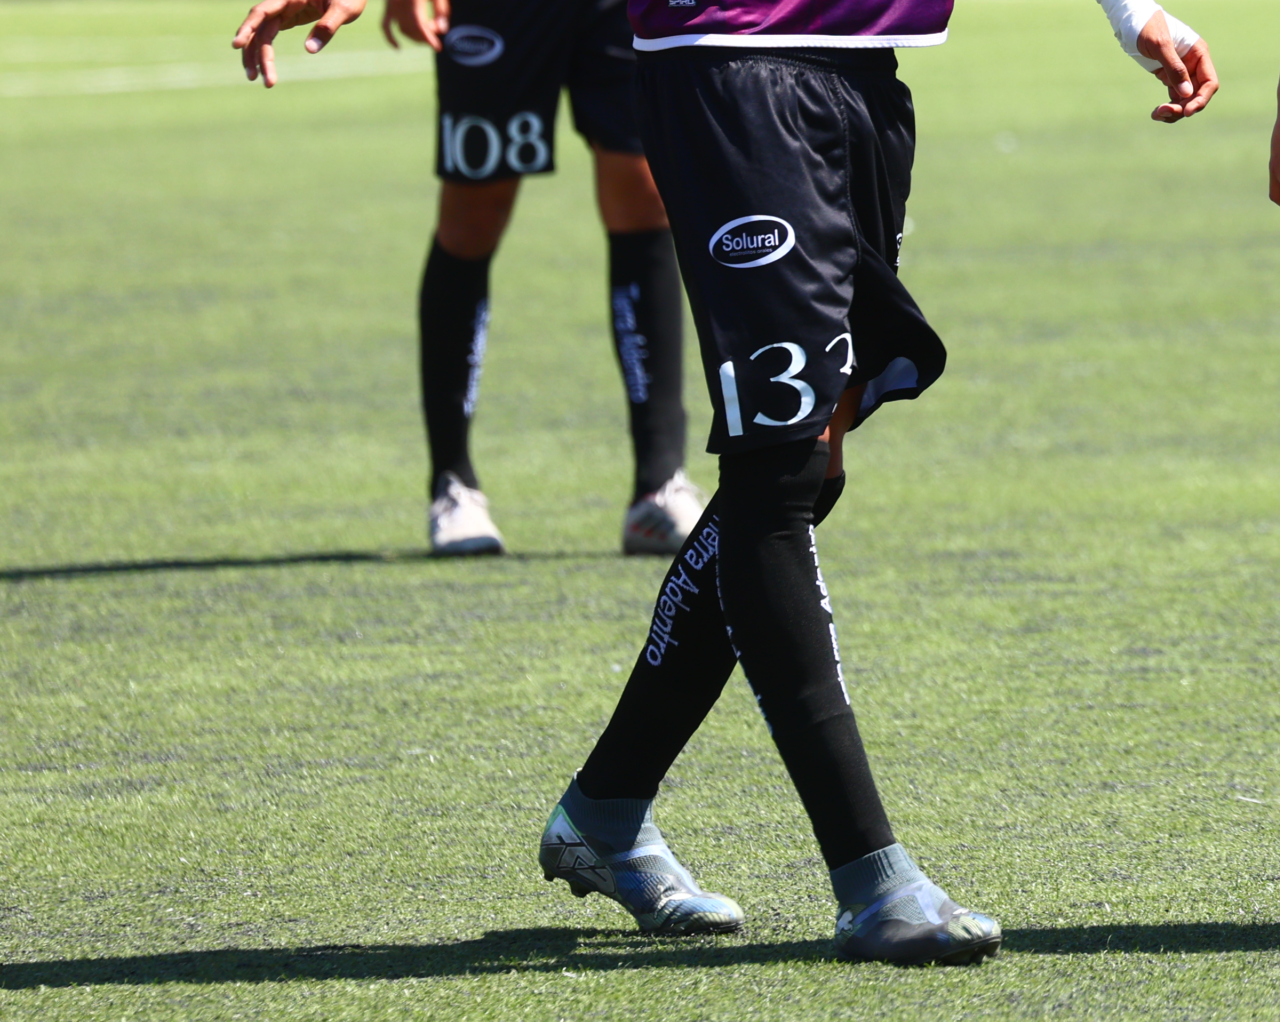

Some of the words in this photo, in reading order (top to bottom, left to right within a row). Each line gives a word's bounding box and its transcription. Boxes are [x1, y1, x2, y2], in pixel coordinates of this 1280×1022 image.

[442, 111, 549, 180] 108
[722, 228, 779, 251] Solural
[646, 563, 699, 667] Adentro
